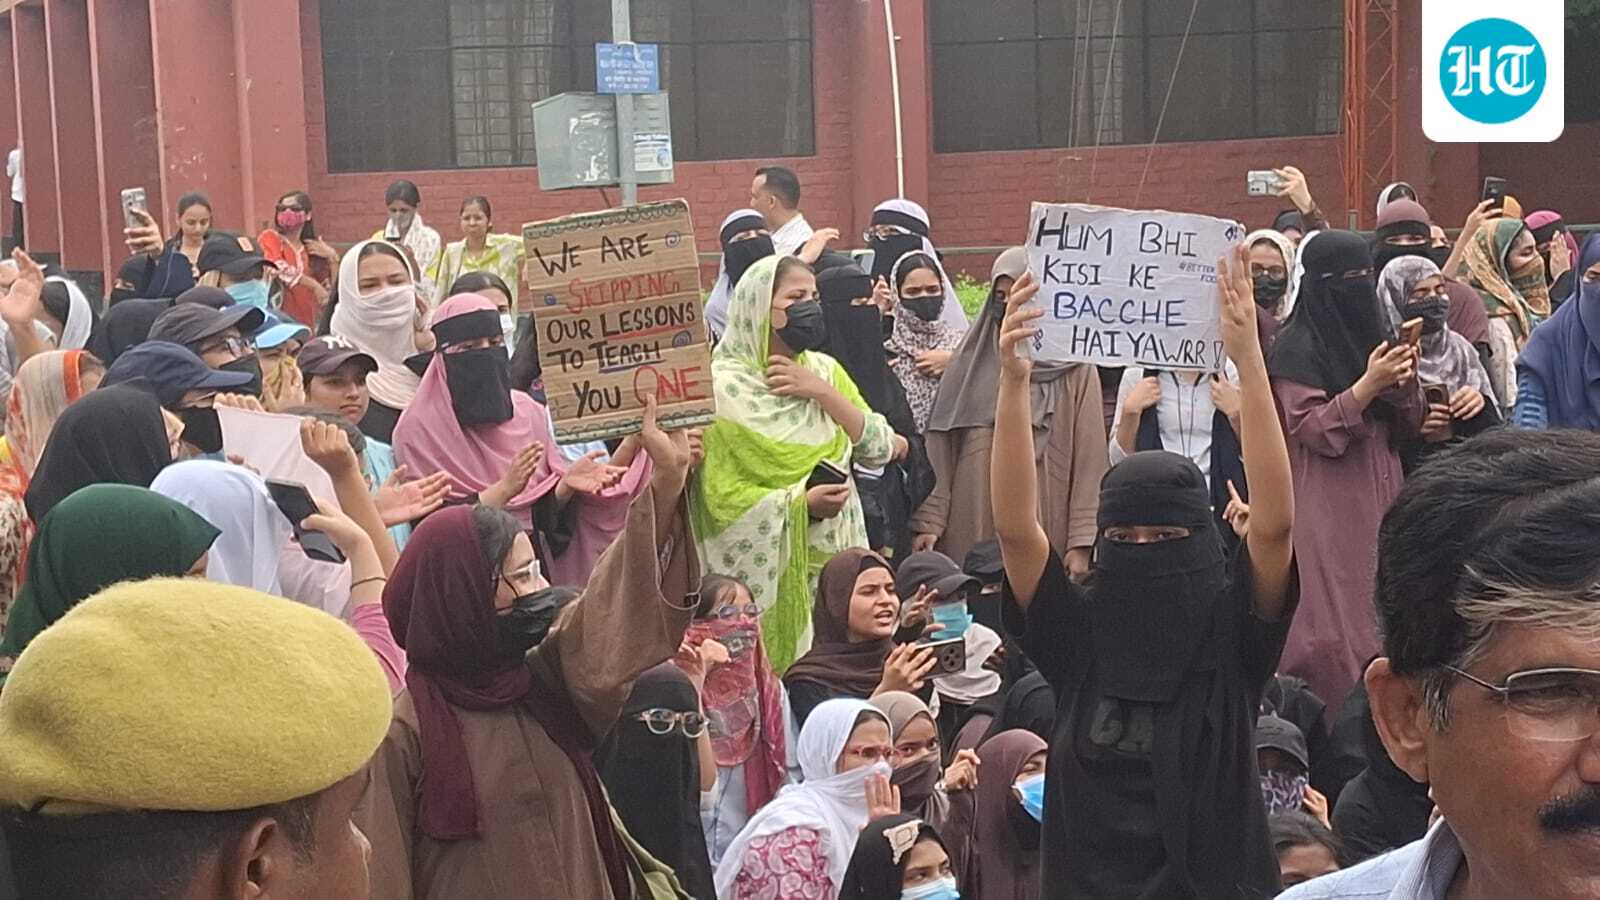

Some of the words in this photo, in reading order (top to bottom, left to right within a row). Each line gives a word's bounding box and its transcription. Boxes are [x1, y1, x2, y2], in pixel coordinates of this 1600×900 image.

[1035, 209, 1113, 256] HUM
[1139, 221, 1197, 257] BHI
[534, 241, 583, 277] WE
[601, 233, 654, 263] ARE
[1043, 254, 1102, 286] KISI
[1129, 263, 1160, 290] KE
[567, 270, 681, 313] SKIPPING
[1054, 292, 1187, 327] BACCHE
[546, 319, 593, 344] OUR
[600, 302, 696, 337] LESSONS
[546, 348, 584, 373] TO
[588, 341, 662, 367] TEACH
[573, 380, 621, 418] YOU
[633, 366, 706, 406] ONE
